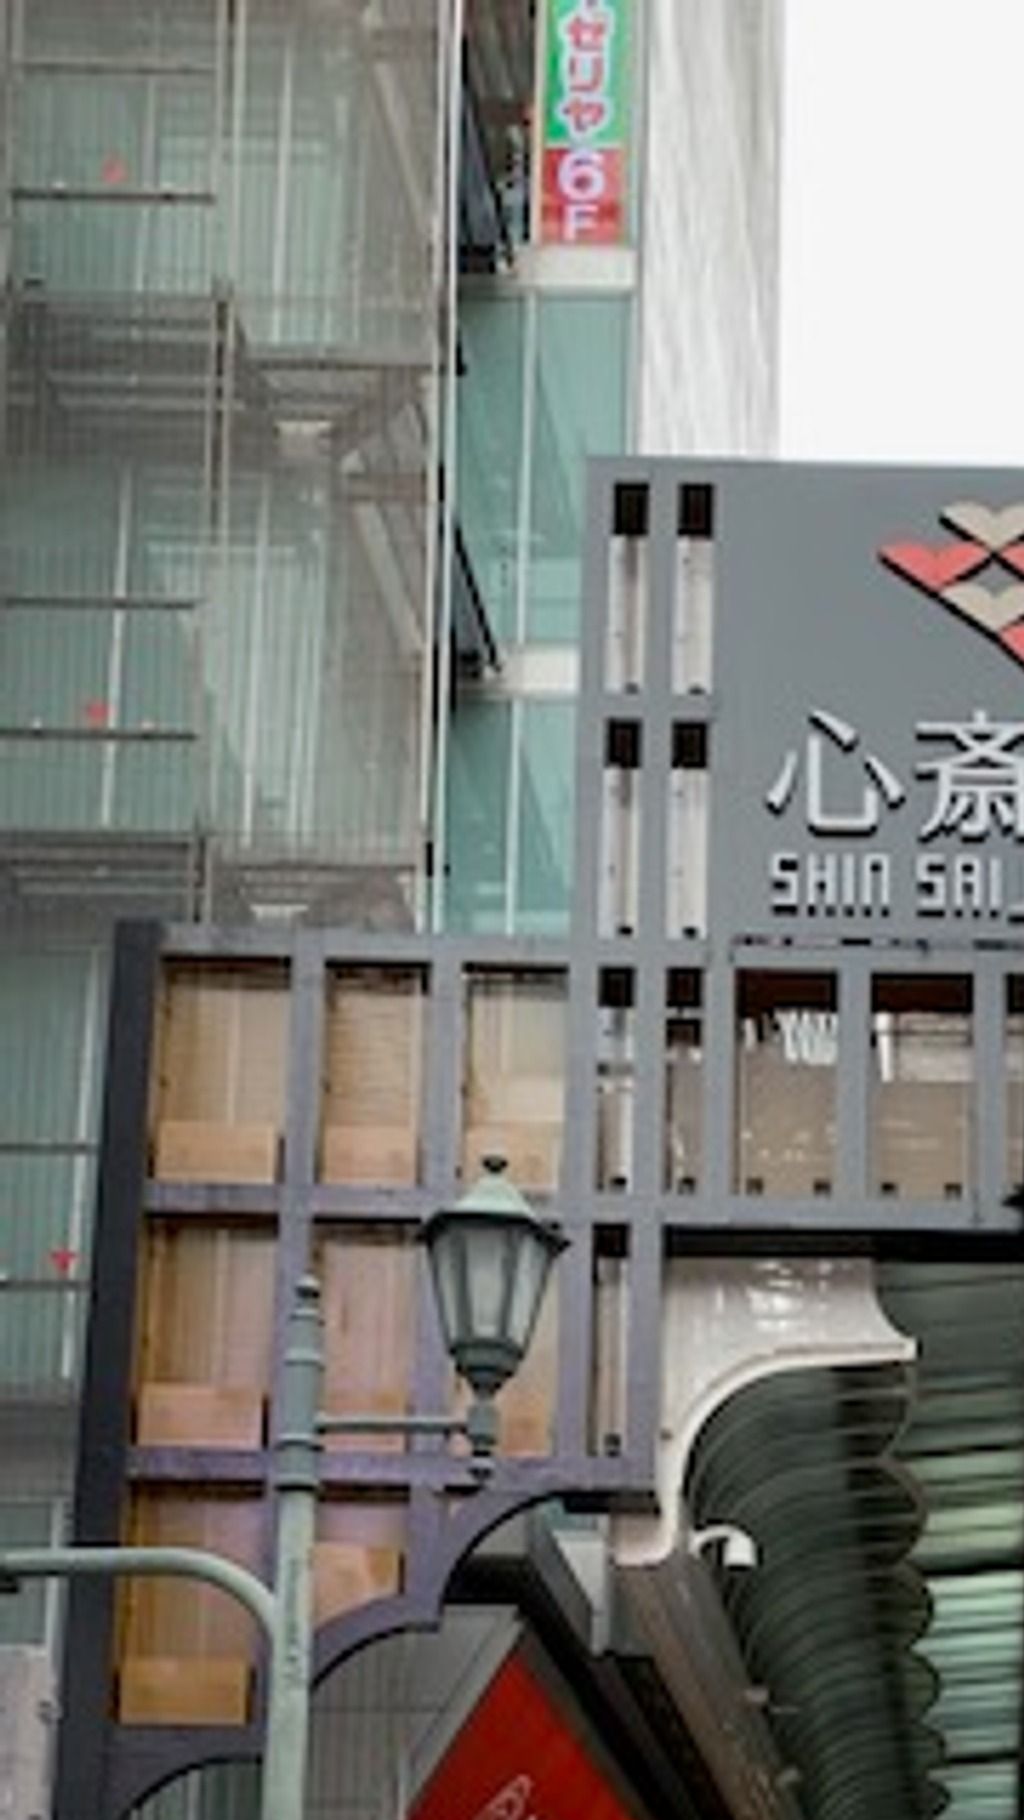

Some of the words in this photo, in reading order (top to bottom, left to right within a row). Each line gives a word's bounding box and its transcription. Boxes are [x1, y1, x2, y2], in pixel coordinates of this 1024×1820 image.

[562, 0, 612, 138] ゼリヤ
[557, 150, 606, 242] 6F
[772, 853, 891, 908] SHIN
[917, 854, 1001, 909] SAI
